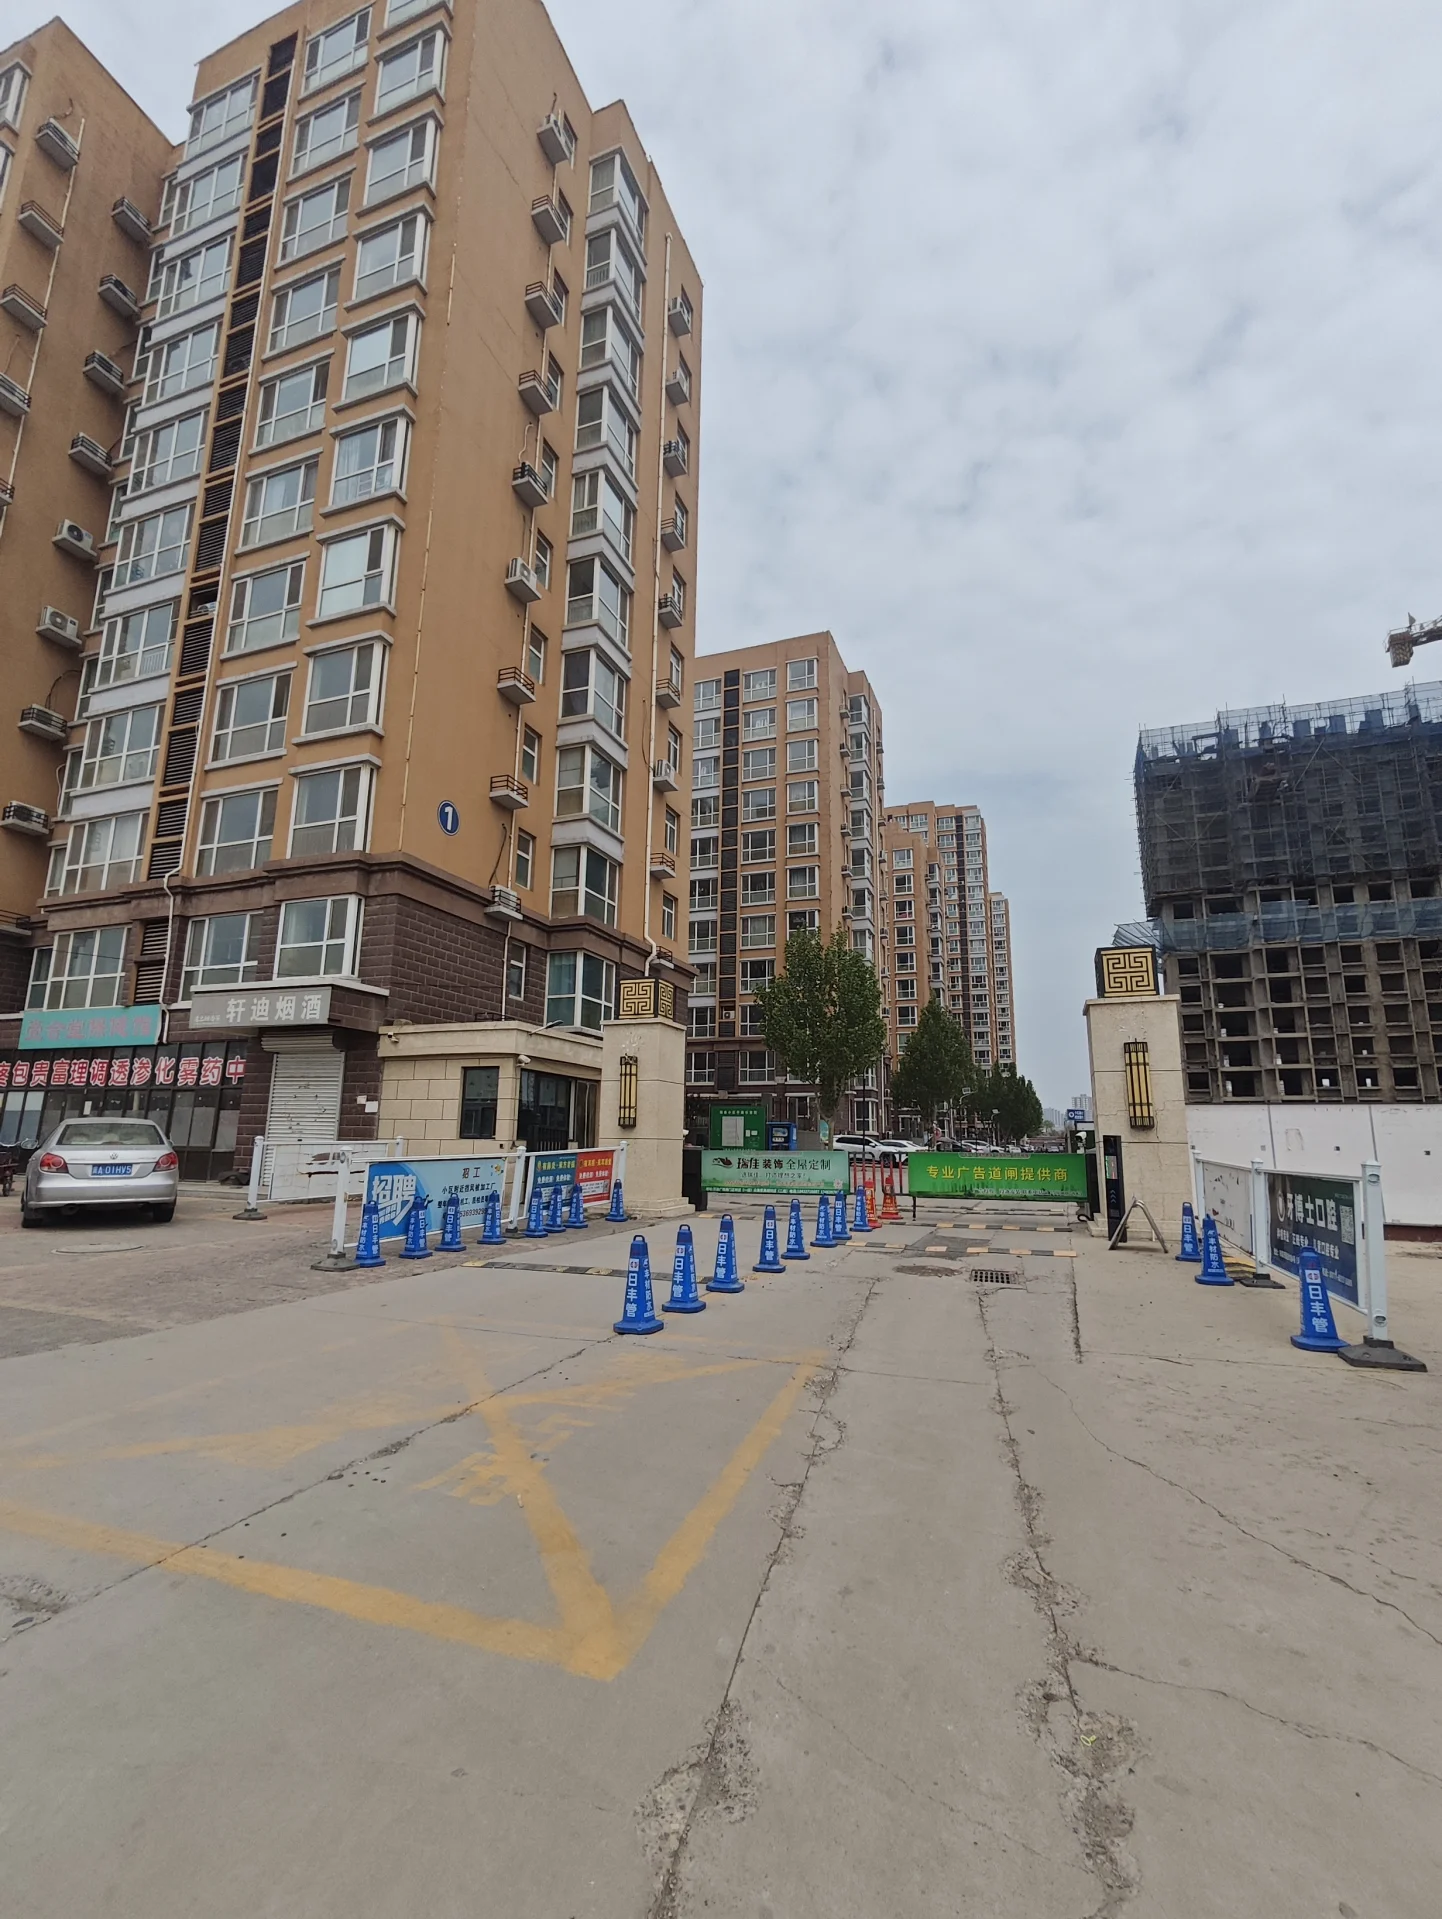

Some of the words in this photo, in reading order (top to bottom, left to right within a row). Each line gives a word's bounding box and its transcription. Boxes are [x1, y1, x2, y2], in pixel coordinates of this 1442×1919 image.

[445, 806, 454, 830] 1
[226, 995, 322, 1023] 轩迪烟酒
[462, 1167, 481, 1179] 招工
[926, 1166, 1068, 1182] 专业广告道闸提供商
[371, 1174, 417, 1226] 招聘
[1287, 1193, 1338, 1232] 牙博士口腔
[765, 1229, 775, 1261] 日丰管
[1183, 1225, 1194, 1252] 日丰管
[672, 1258, 684, 1298] 日丰管
[715, 1243, 727, 1279] 日丰管
[626, 1273, 638, 1318] 日丰管
[1308, 1285, 1329, 1333] 日丰管
